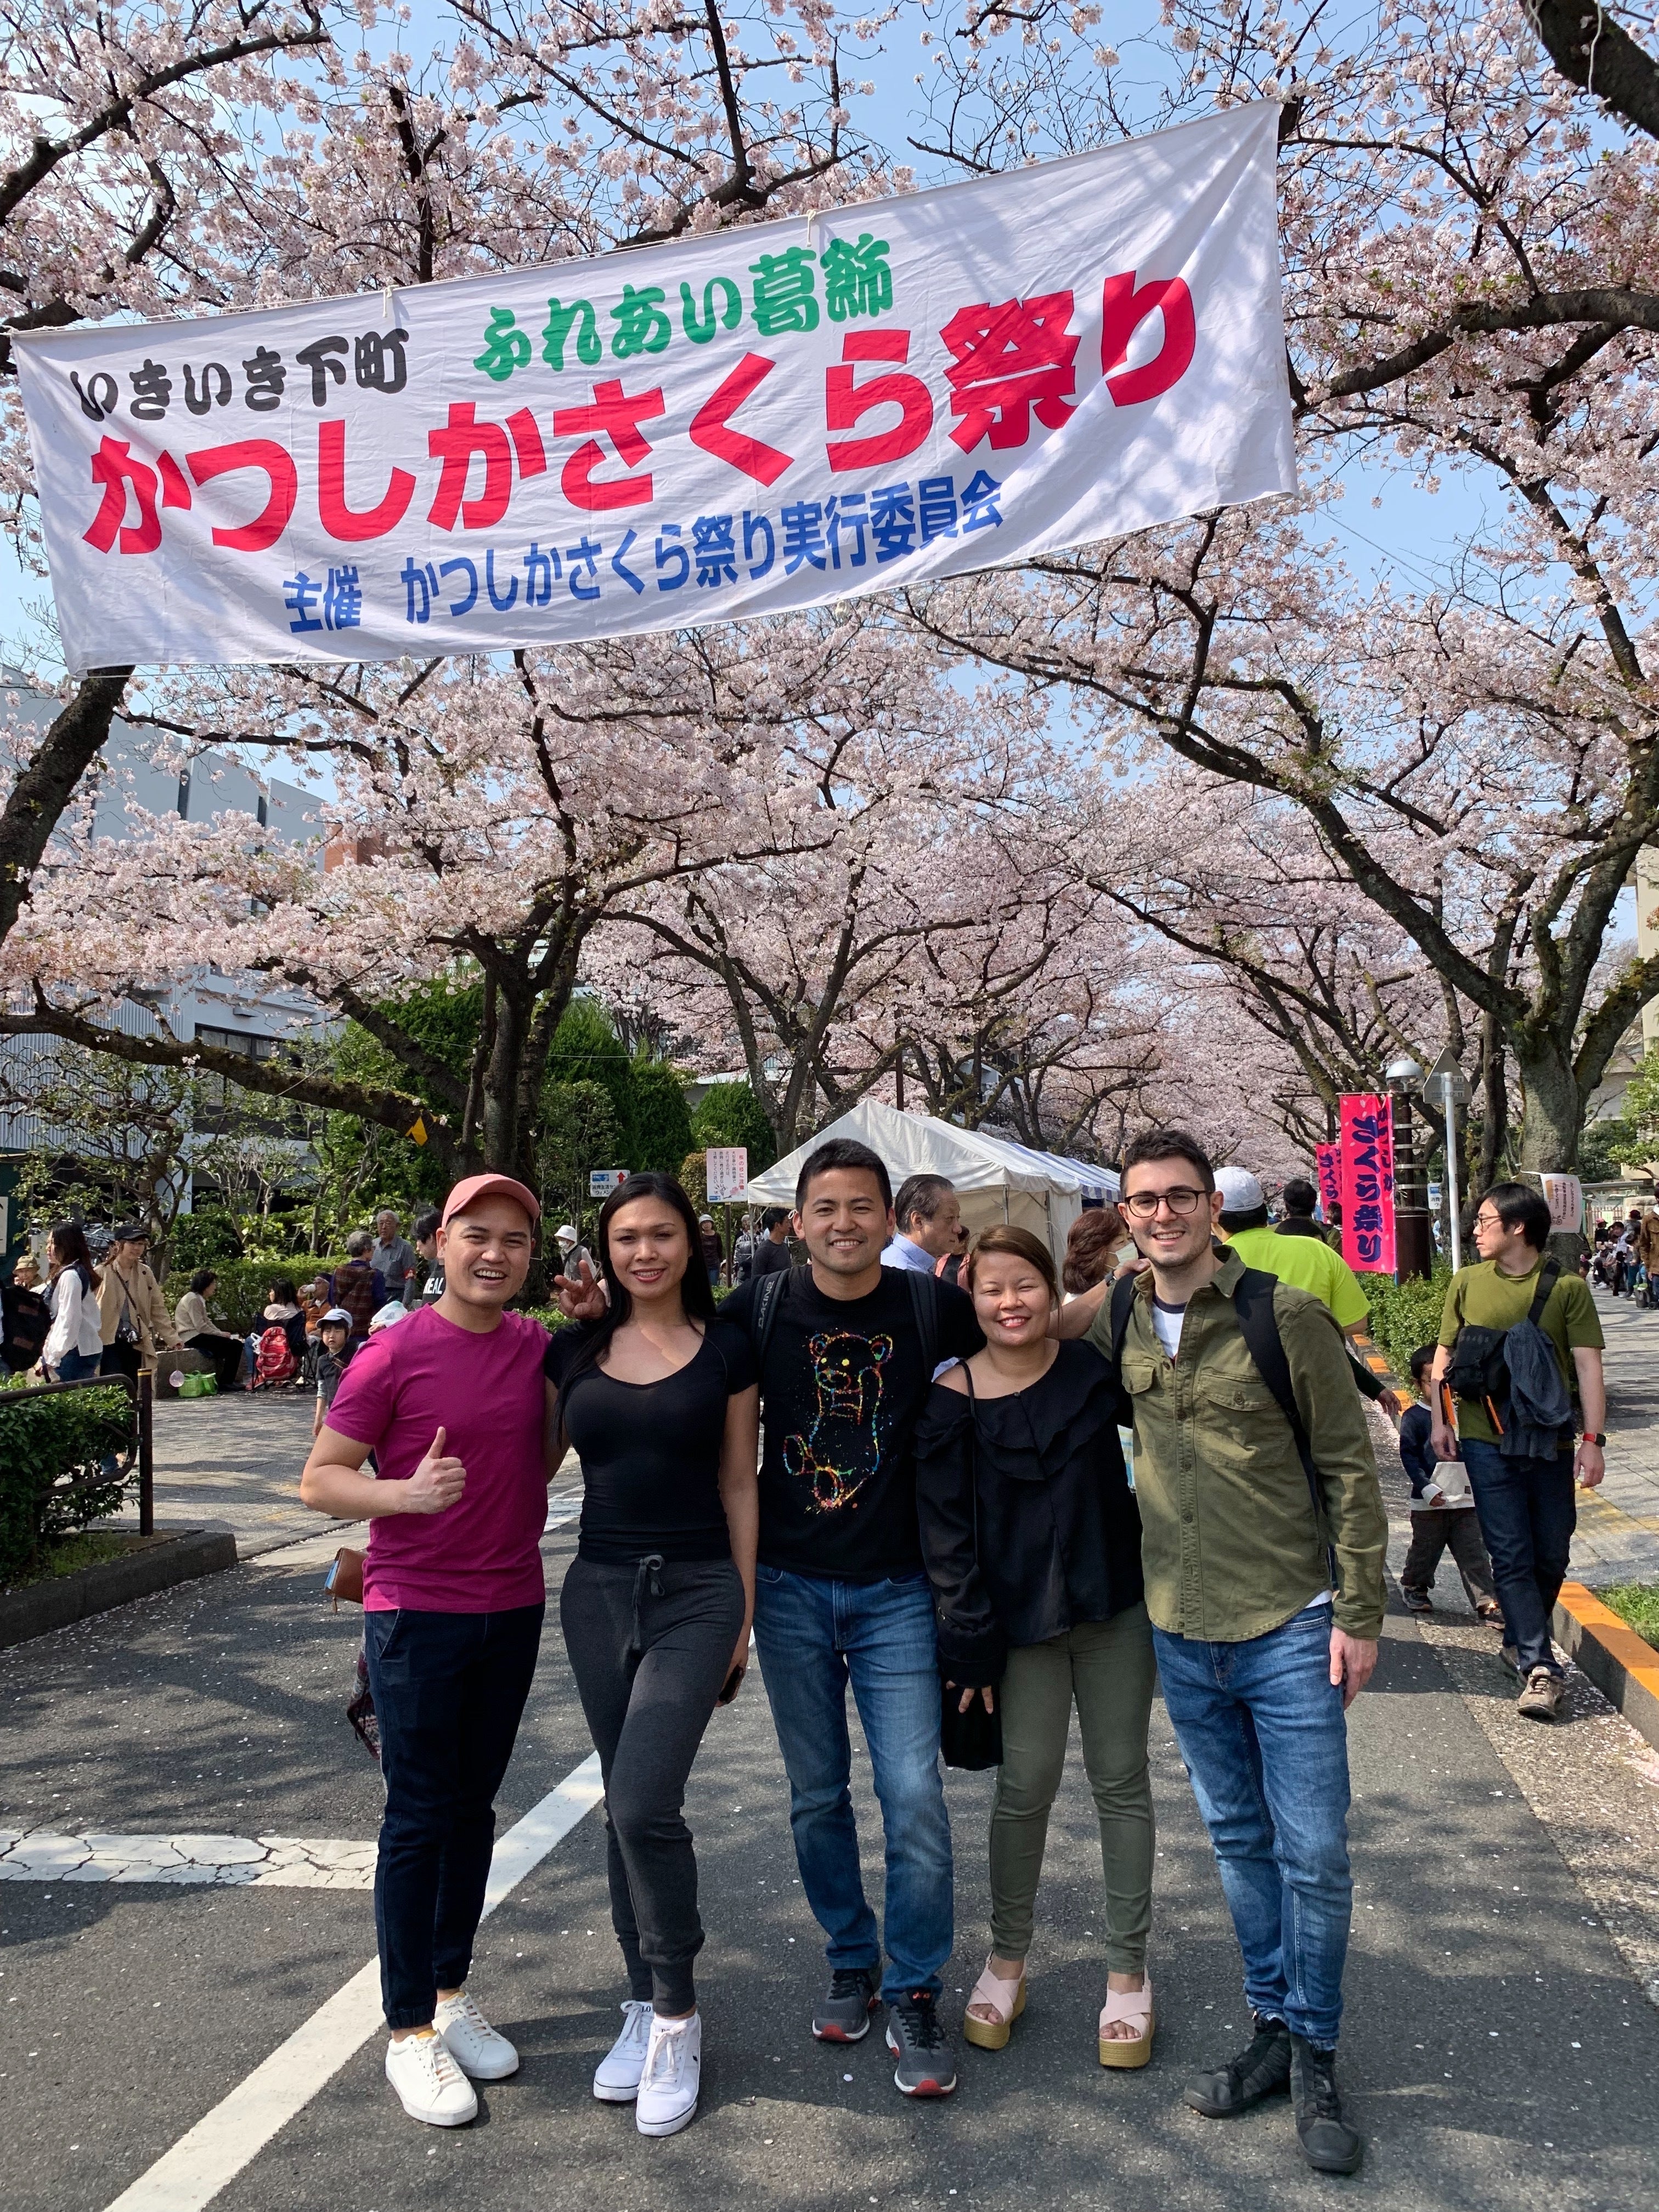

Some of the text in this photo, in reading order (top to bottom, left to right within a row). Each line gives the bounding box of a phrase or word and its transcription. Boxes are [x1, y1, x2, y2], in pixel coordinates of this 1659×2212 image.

[71, 234, 892, 421] いきいき下町 ふれあい葛飾
[84, 271, 1195, 554] かつしかさくら祭り
[284, 470, 1003, 633] 主催 かつしかさくら祭り実行委員会
[1352, 1115, 1383, 1263] さくら祭り
[758, 1280, 775, 1329] DAKINE
